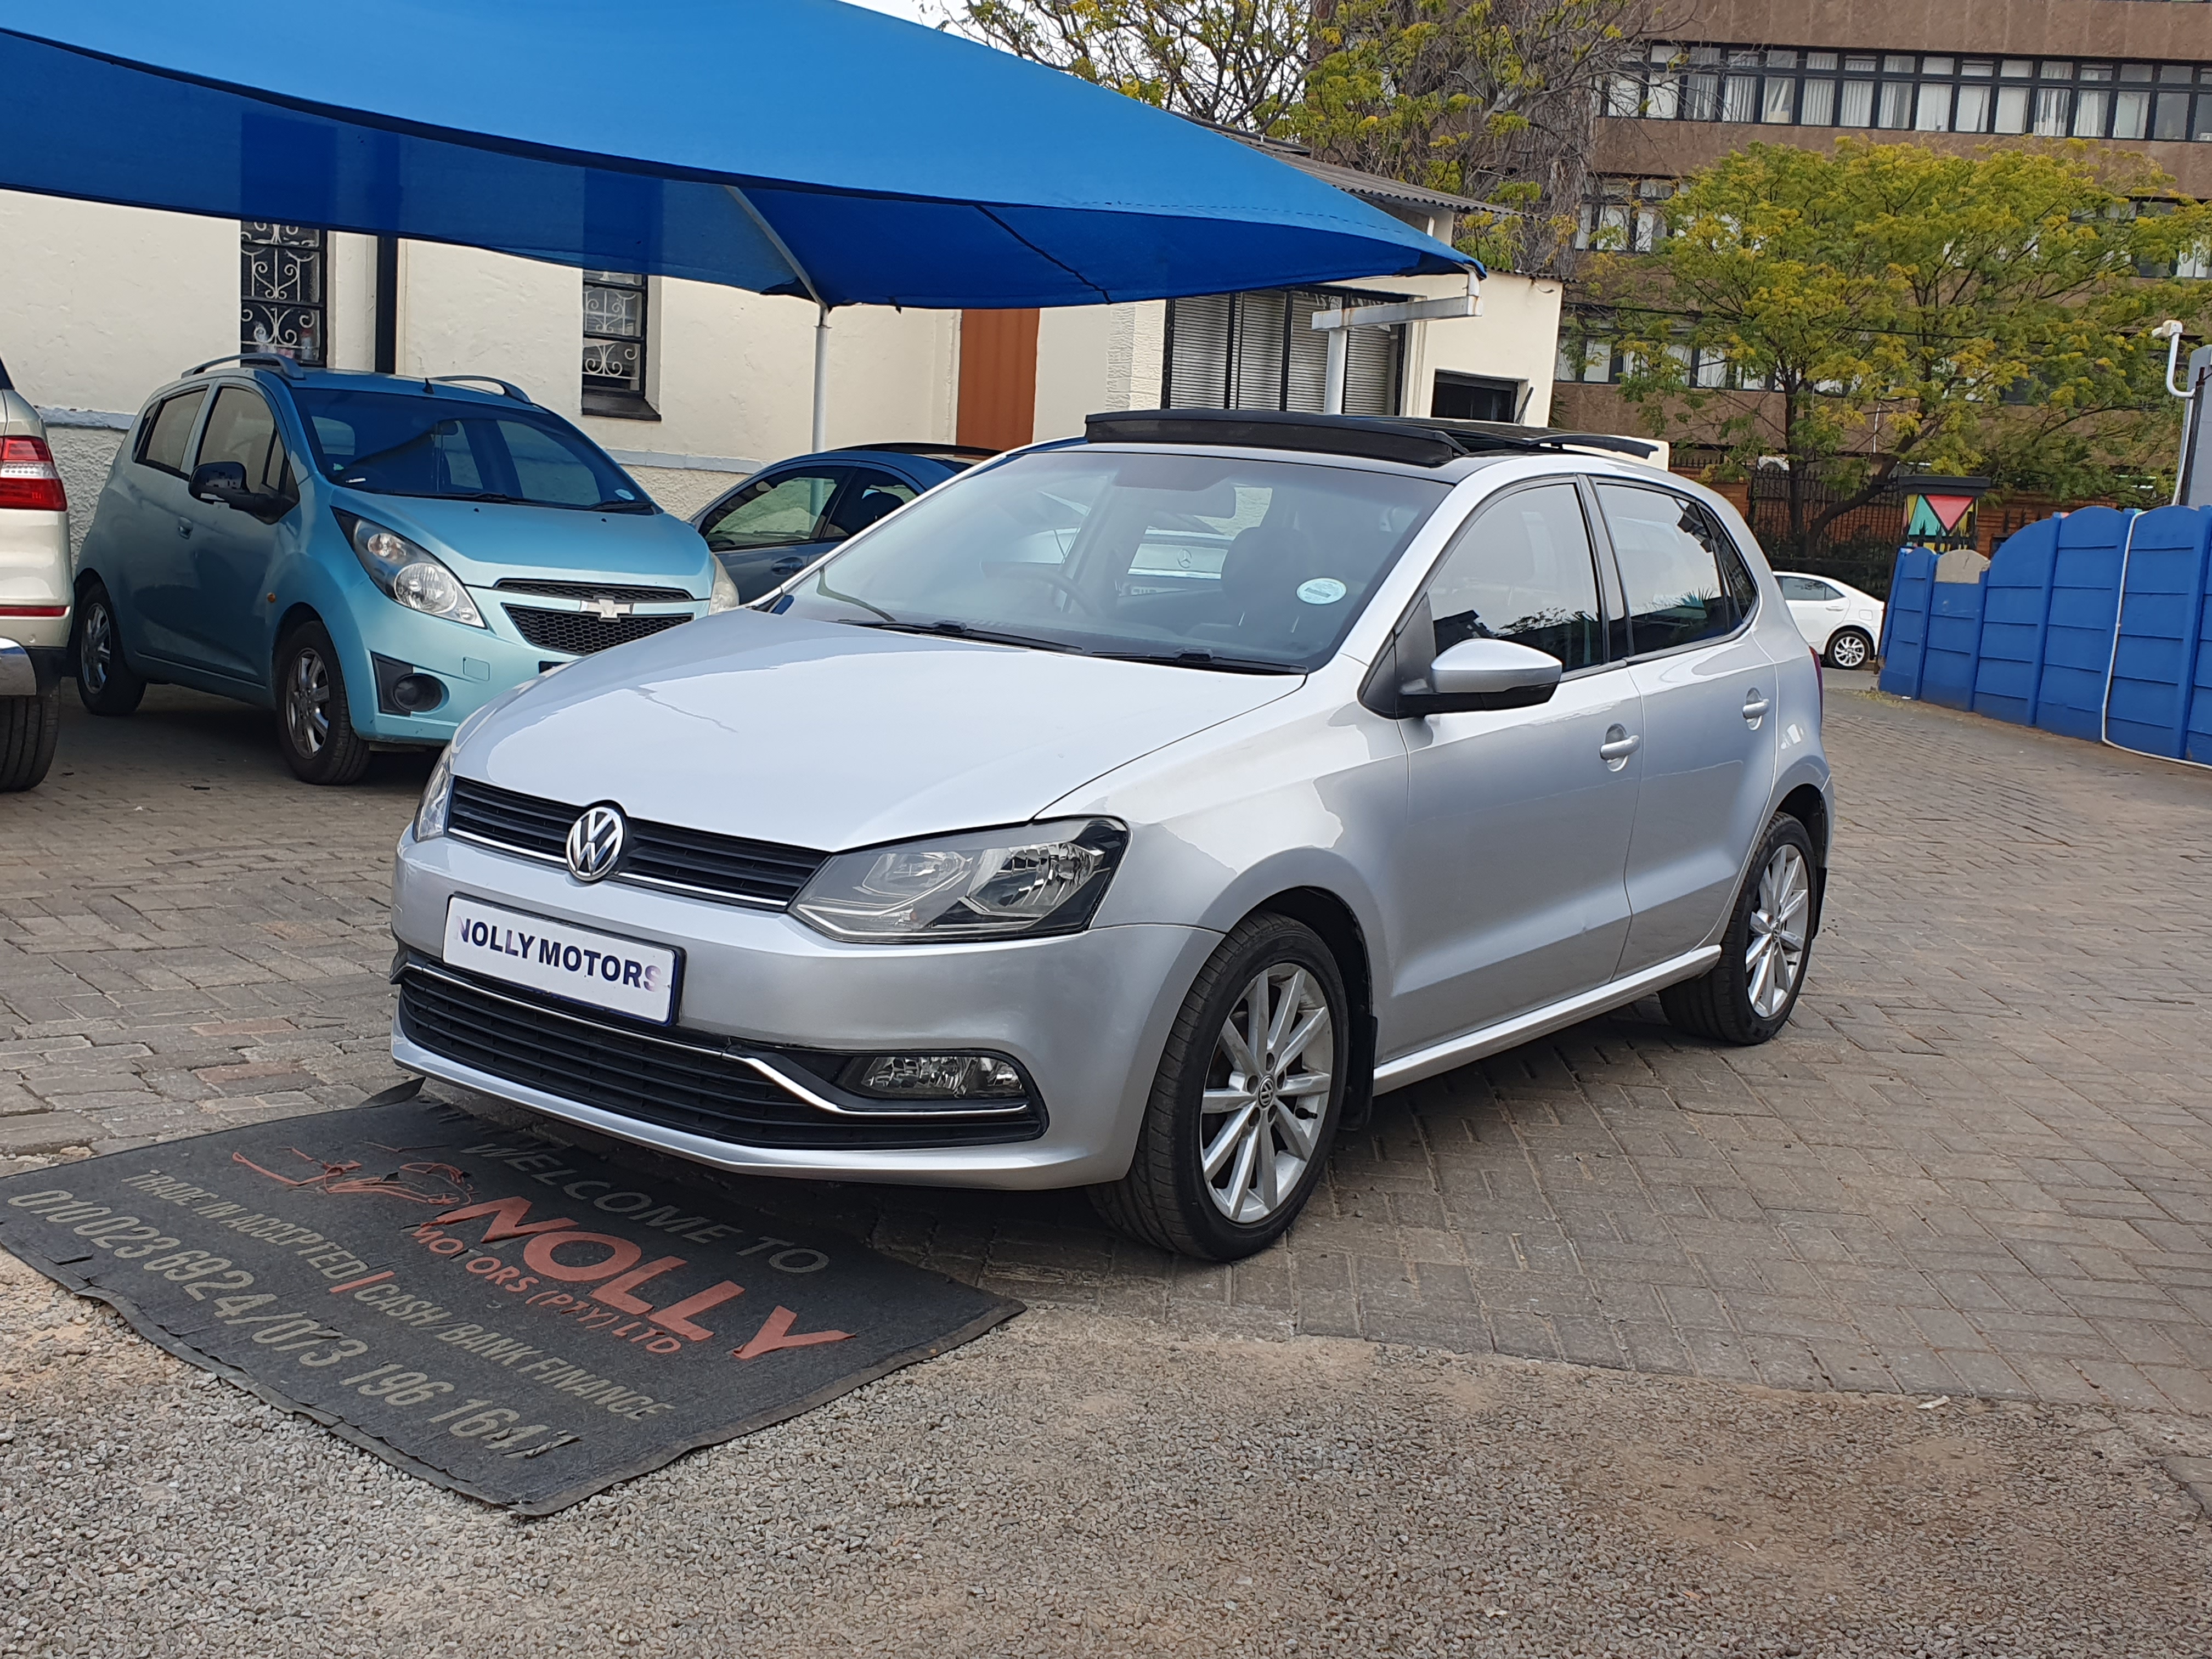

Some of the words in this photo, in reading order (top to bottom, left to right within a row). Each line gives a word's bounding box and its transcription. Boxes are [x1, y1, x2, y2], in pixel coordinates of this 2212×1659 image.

[455, 915, 535, 959] NOLLY
[539, 938, 662, 992] MOTORS
[121, 1169, 219, 1206] TRADE
[192, 1201, 247, 1219] IN
[461, 1143, 743, 1243] WELCOME
[736, 1235, 830, 1273] TO
[219, 1212, 369, 1280] ACCEPTED
[420, 1195, 856, 1359] NOLLY
[7, 1190, 112, 1223] 010
[73, 1216, 181, 1259] 023
[338, 1363, 455, 1406] 196
[354, 1283, 545, 1366] CASH/BANK
[525, 1290, 619, 1329] (PTY)
[612, 1321, 681, 1353] LTD
[524, 1357, 676, 1422] FINANCE
